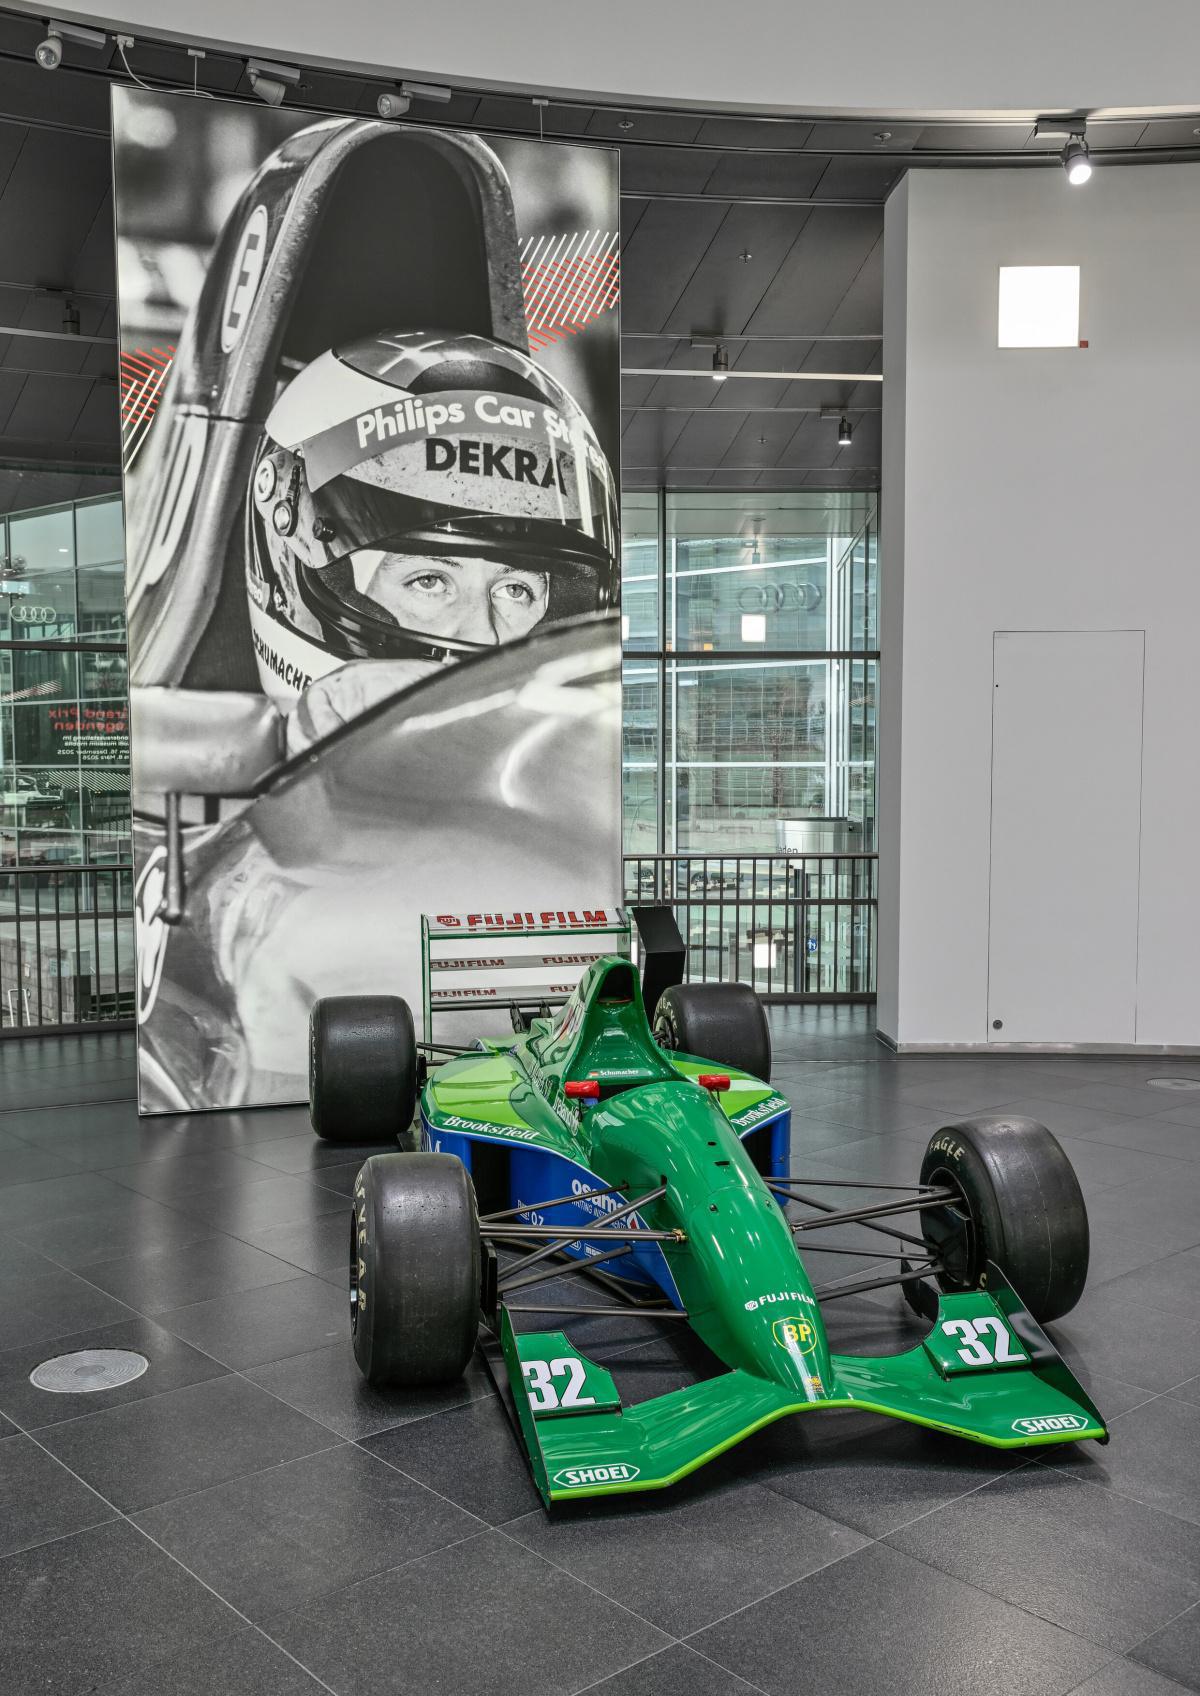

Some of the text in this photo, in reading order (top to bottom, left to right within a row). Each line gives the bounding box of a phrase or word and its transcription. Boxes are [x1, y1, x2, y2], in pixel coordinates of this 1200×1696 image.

[356, 398, 466, 448] Philips
[474, 395, 535, 430] Car
[425, 437, 568, 497] DEKRA
[600, 1068, 639, 1077] Schumacher
[443, 1115, 540, 1140] Brooksfield
[782, 1323, 812, 1343] BP
[942, 1316, 1028, 1366] 32
[520, 1357, 596, 1411] 32
[1021, 1416, 1081, 1434] SHOEI
[564, 1465, 630, 1485] SHOEI
